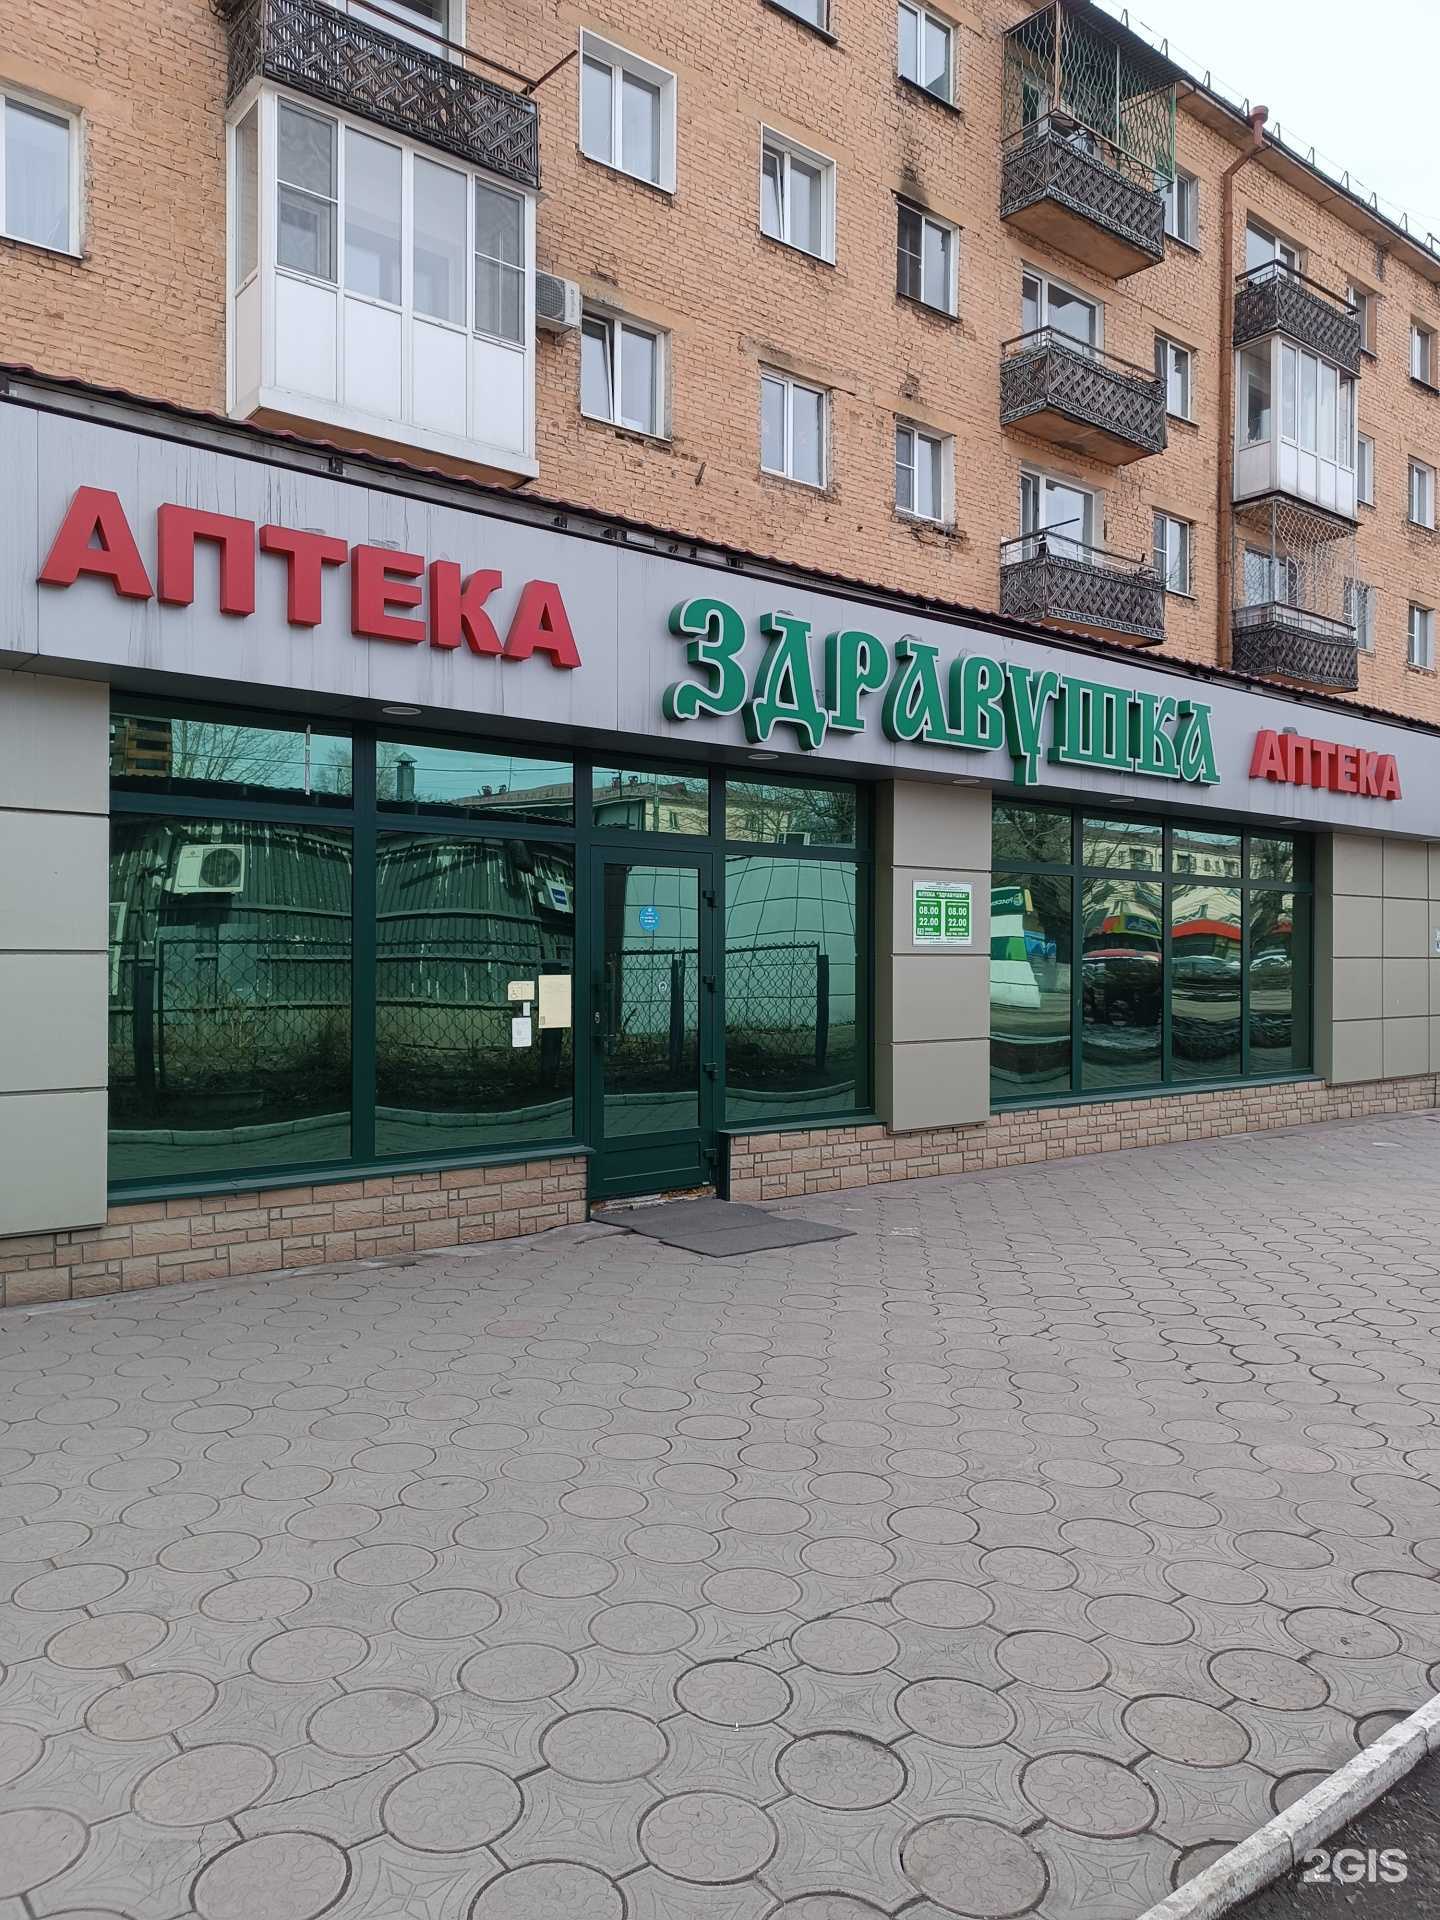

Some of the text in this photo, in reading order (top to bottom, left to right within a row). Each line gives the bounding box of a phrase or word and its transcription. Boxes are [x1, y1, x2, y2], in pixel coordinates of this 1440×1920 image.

[38, 486, 582, 669] АПТЕКА
[663, 598, 1221, 786] ЗДРАВУШКА
[1249, 730, 1402, 801] АПТЕКА
[919, 918, 939, 926] 22.00
[947, 918, 967, 927] 22.00
